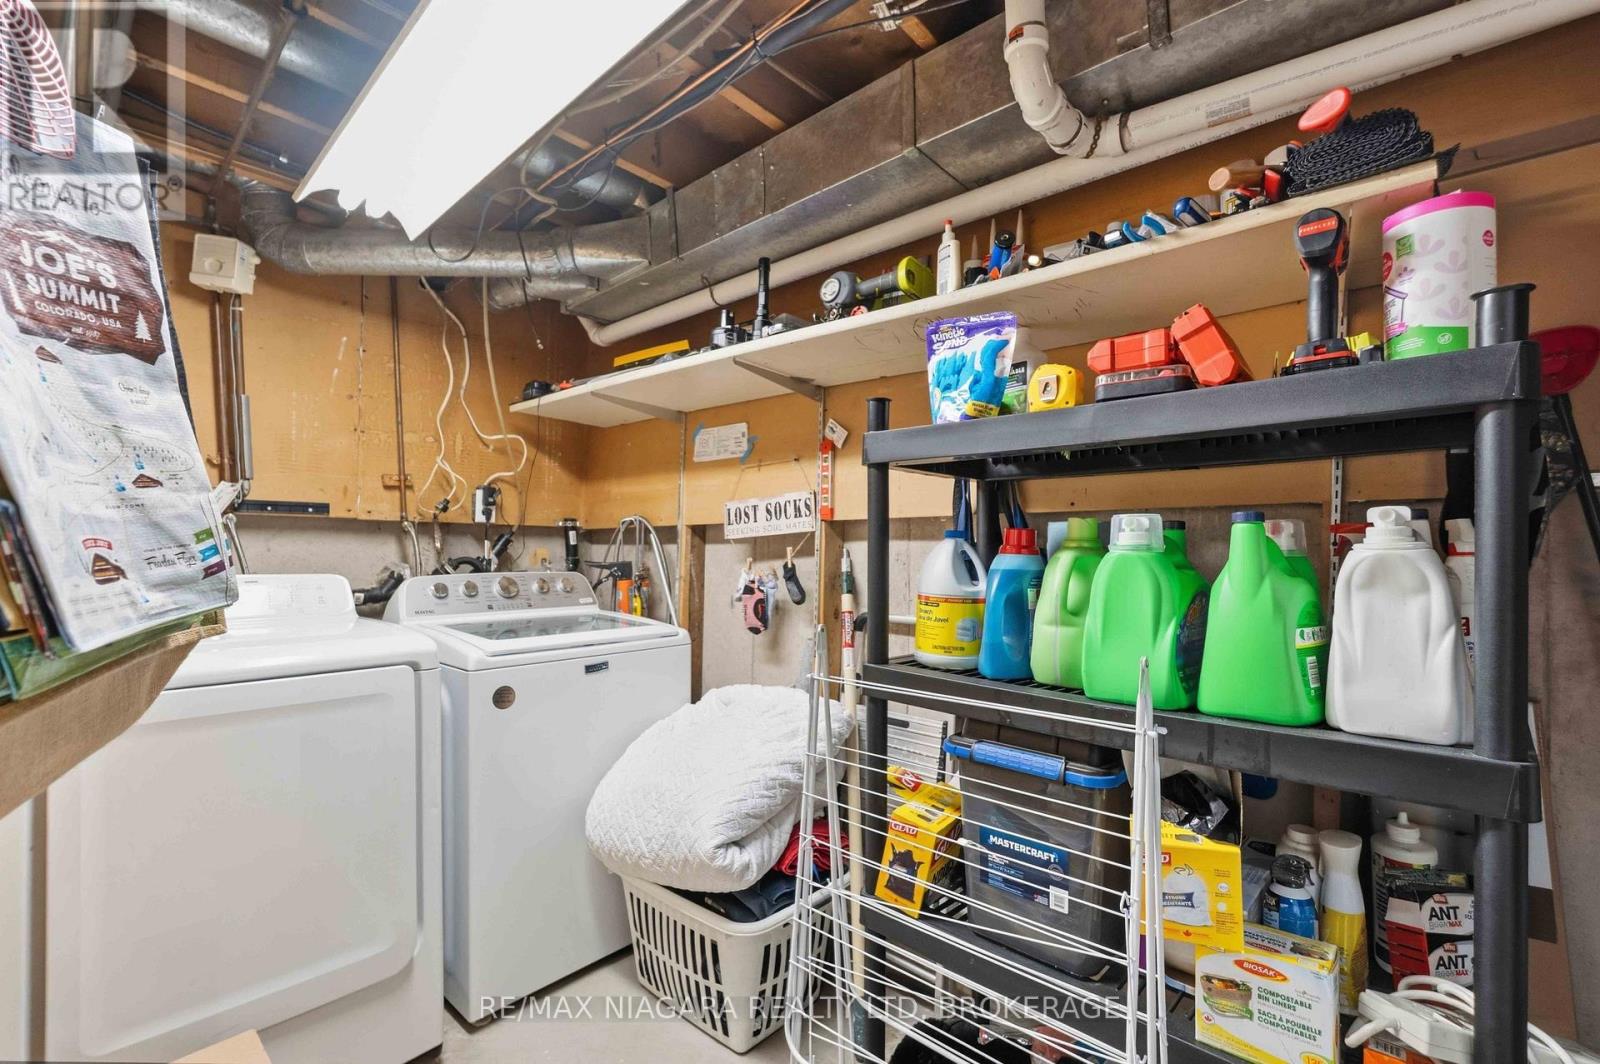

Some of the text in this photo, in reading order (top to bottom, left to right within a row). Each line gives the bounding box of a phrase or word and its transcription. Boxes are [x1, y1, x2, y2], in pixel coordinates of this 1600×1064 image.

[19, 239, 118, 289] JOE'S
[24, 272, 121, 314] SUMMIT
[727, 496, 813, 526] LOST SOCKS
[989, 834, 1058, 863] MASTERCRAFT
[1428, 906, 1460, 921] ANT
[1242, 960, 1276, 978] BIOSAK
[1435, 954, 1468, 971] ANT
[1257, 986, 1313, 1011] COMPOSTABLE
[1257, 993, 1271, 1005] BIN
[1272, 998, 1298, 1013] LINERS
[1257, 1008, 1278, 1020] SACS
[1285, 1017, 1323, 1037] POUBELLE
[1257, 1016, 1318, 1043] COMPOSTABLES
